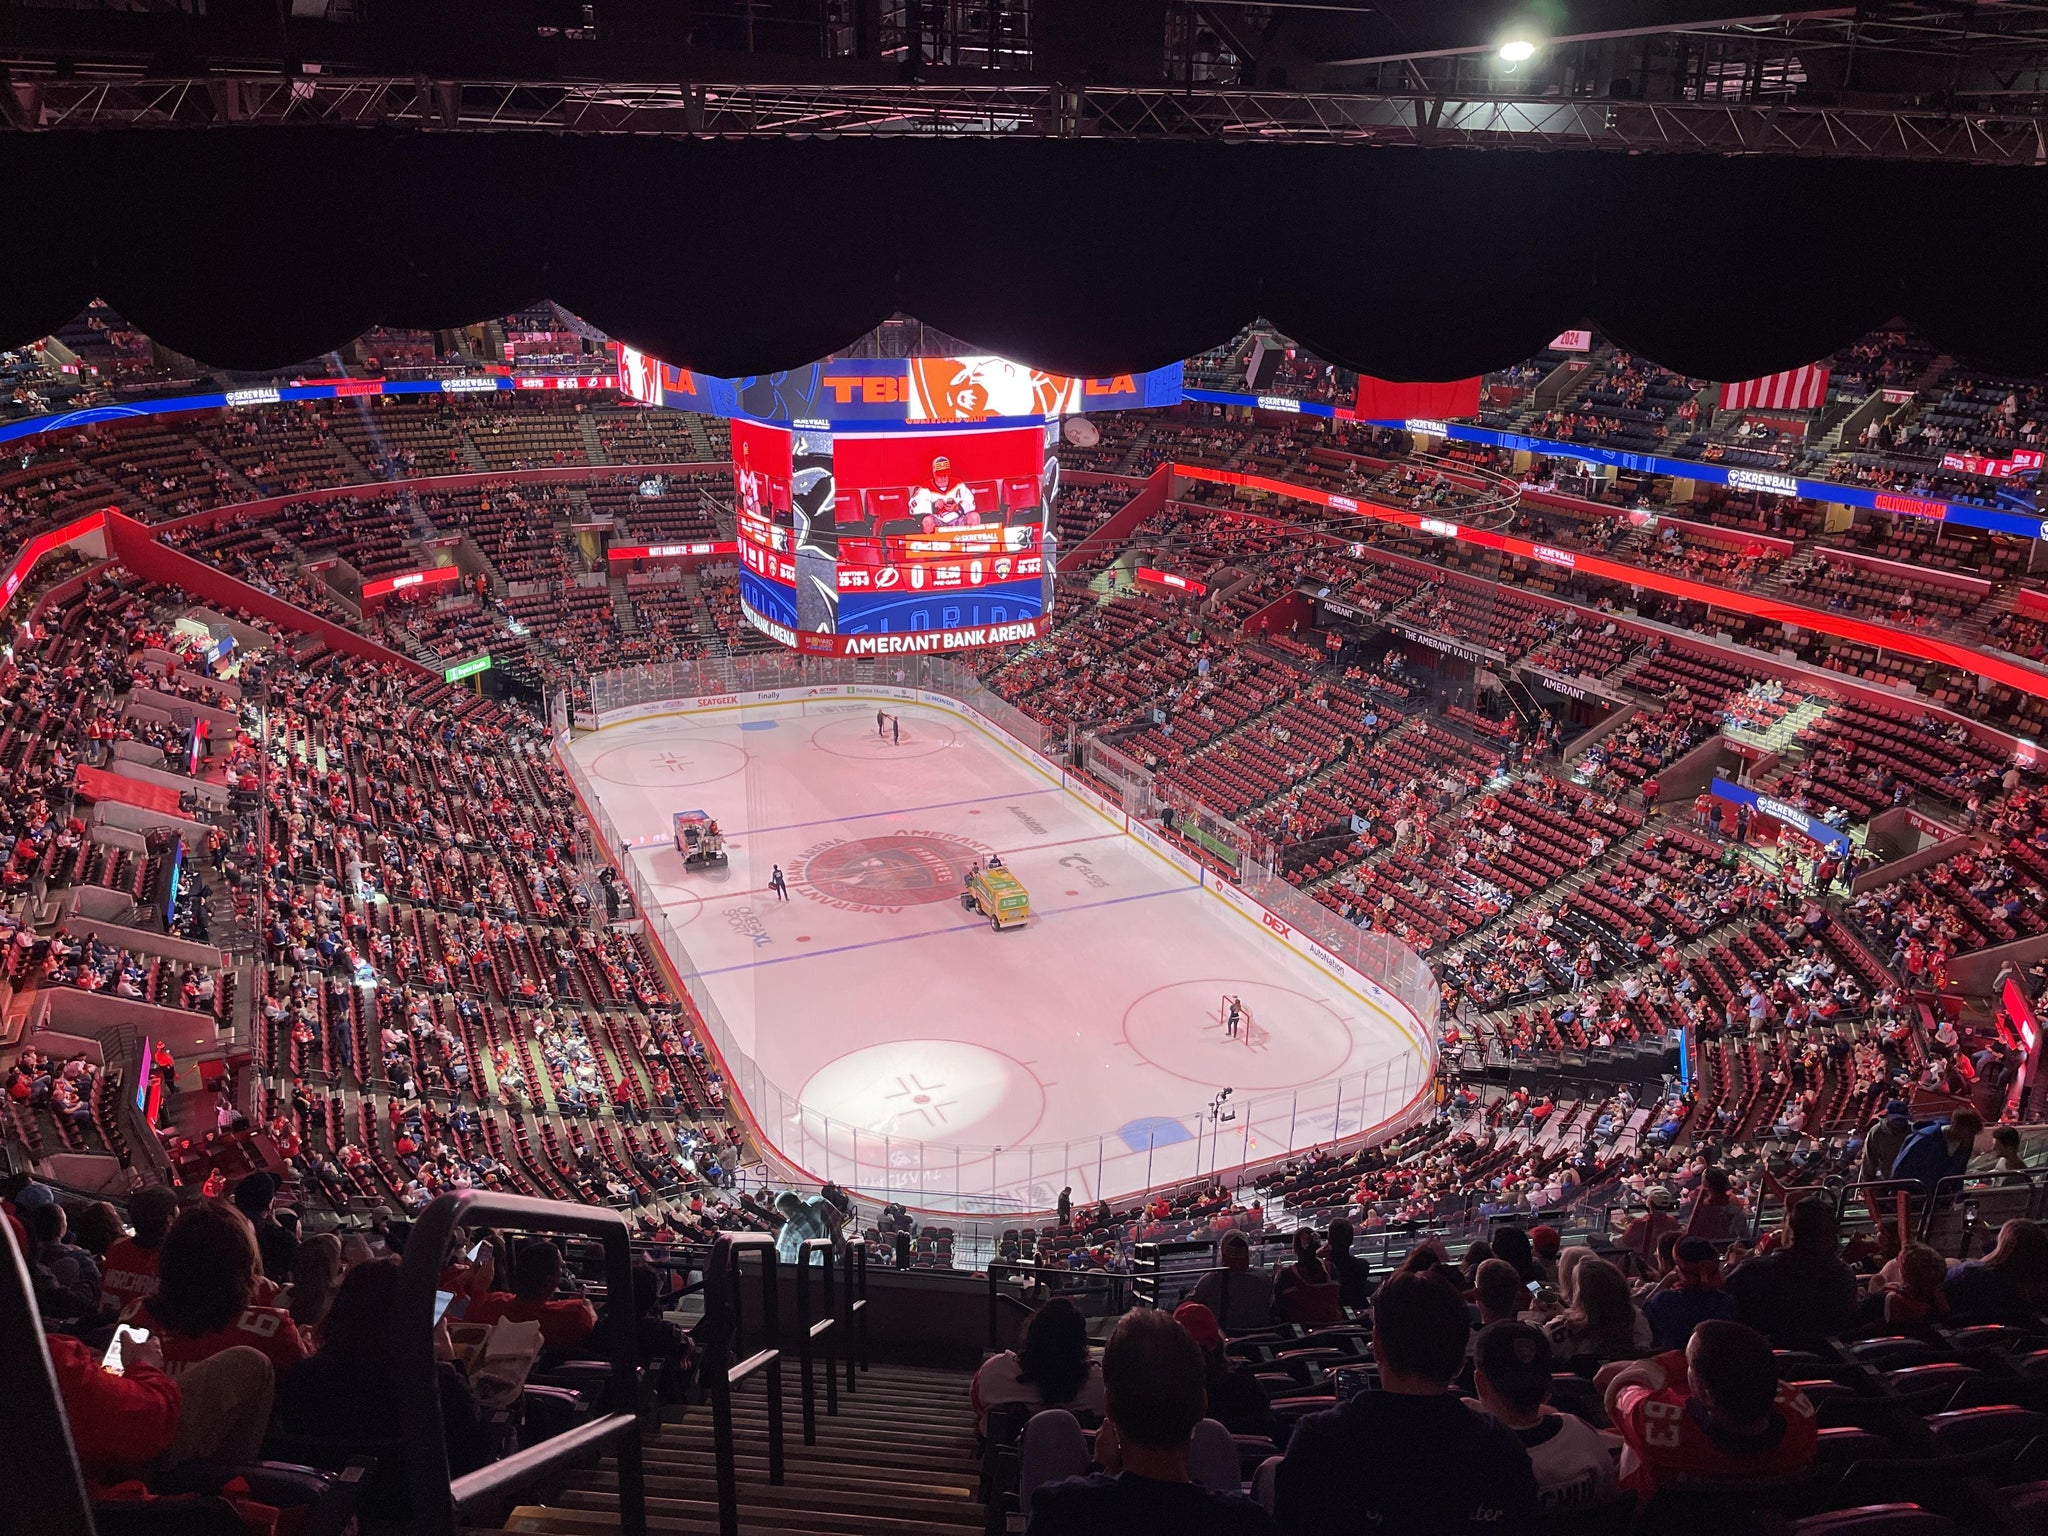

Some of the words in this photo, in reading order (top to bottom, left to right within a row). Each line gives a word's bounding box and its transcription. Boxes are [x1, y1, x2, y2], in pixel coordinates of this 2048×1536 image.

[1561, 332, 1580, 346] 2024
[451, 378, 497, 387] SKREWBALL
[235, 389, 280, 401] SKREWBALL
[1739, 471, 1797, 491] SKREWBALL
[1875, 495, 1922, 514] OBLIVIOUS
[1924, 502, 1945, 519] CAM
[1323, 601, 1353, 619] AMERANT
[753, 612, 770, 636] BANK
[770, 622, 798, 649] ARENA
[845, 634, 942, 656] AMERANT
[942, 627, 985, 649] BANK
[987, 622, 1036, 644] ARENA
[1405, 629, 1417, 642] THE
[1417, 633, 1452, 654] AMERANT
[1453, 646, 1479, 664] VAULT
[758, 691, 780, 701] finally
[1543, 677, 1585, 701] AMERANT
[697, 695, 738, 708] SEATGEEK
[931, 695, 955, 709] HONDA
[1766, 800, 1810, 829] SKREWBALL
[1910, 816, 1922, 829] 104
[803, 838, 848, 861] ARENA
[894, 829, 996, 851] AMERANT
[795, 887, 904, 915] AMERANT
[1262, 911, 1292, 940] DEX
[1309, 944, 1345, 975] AutoNation
